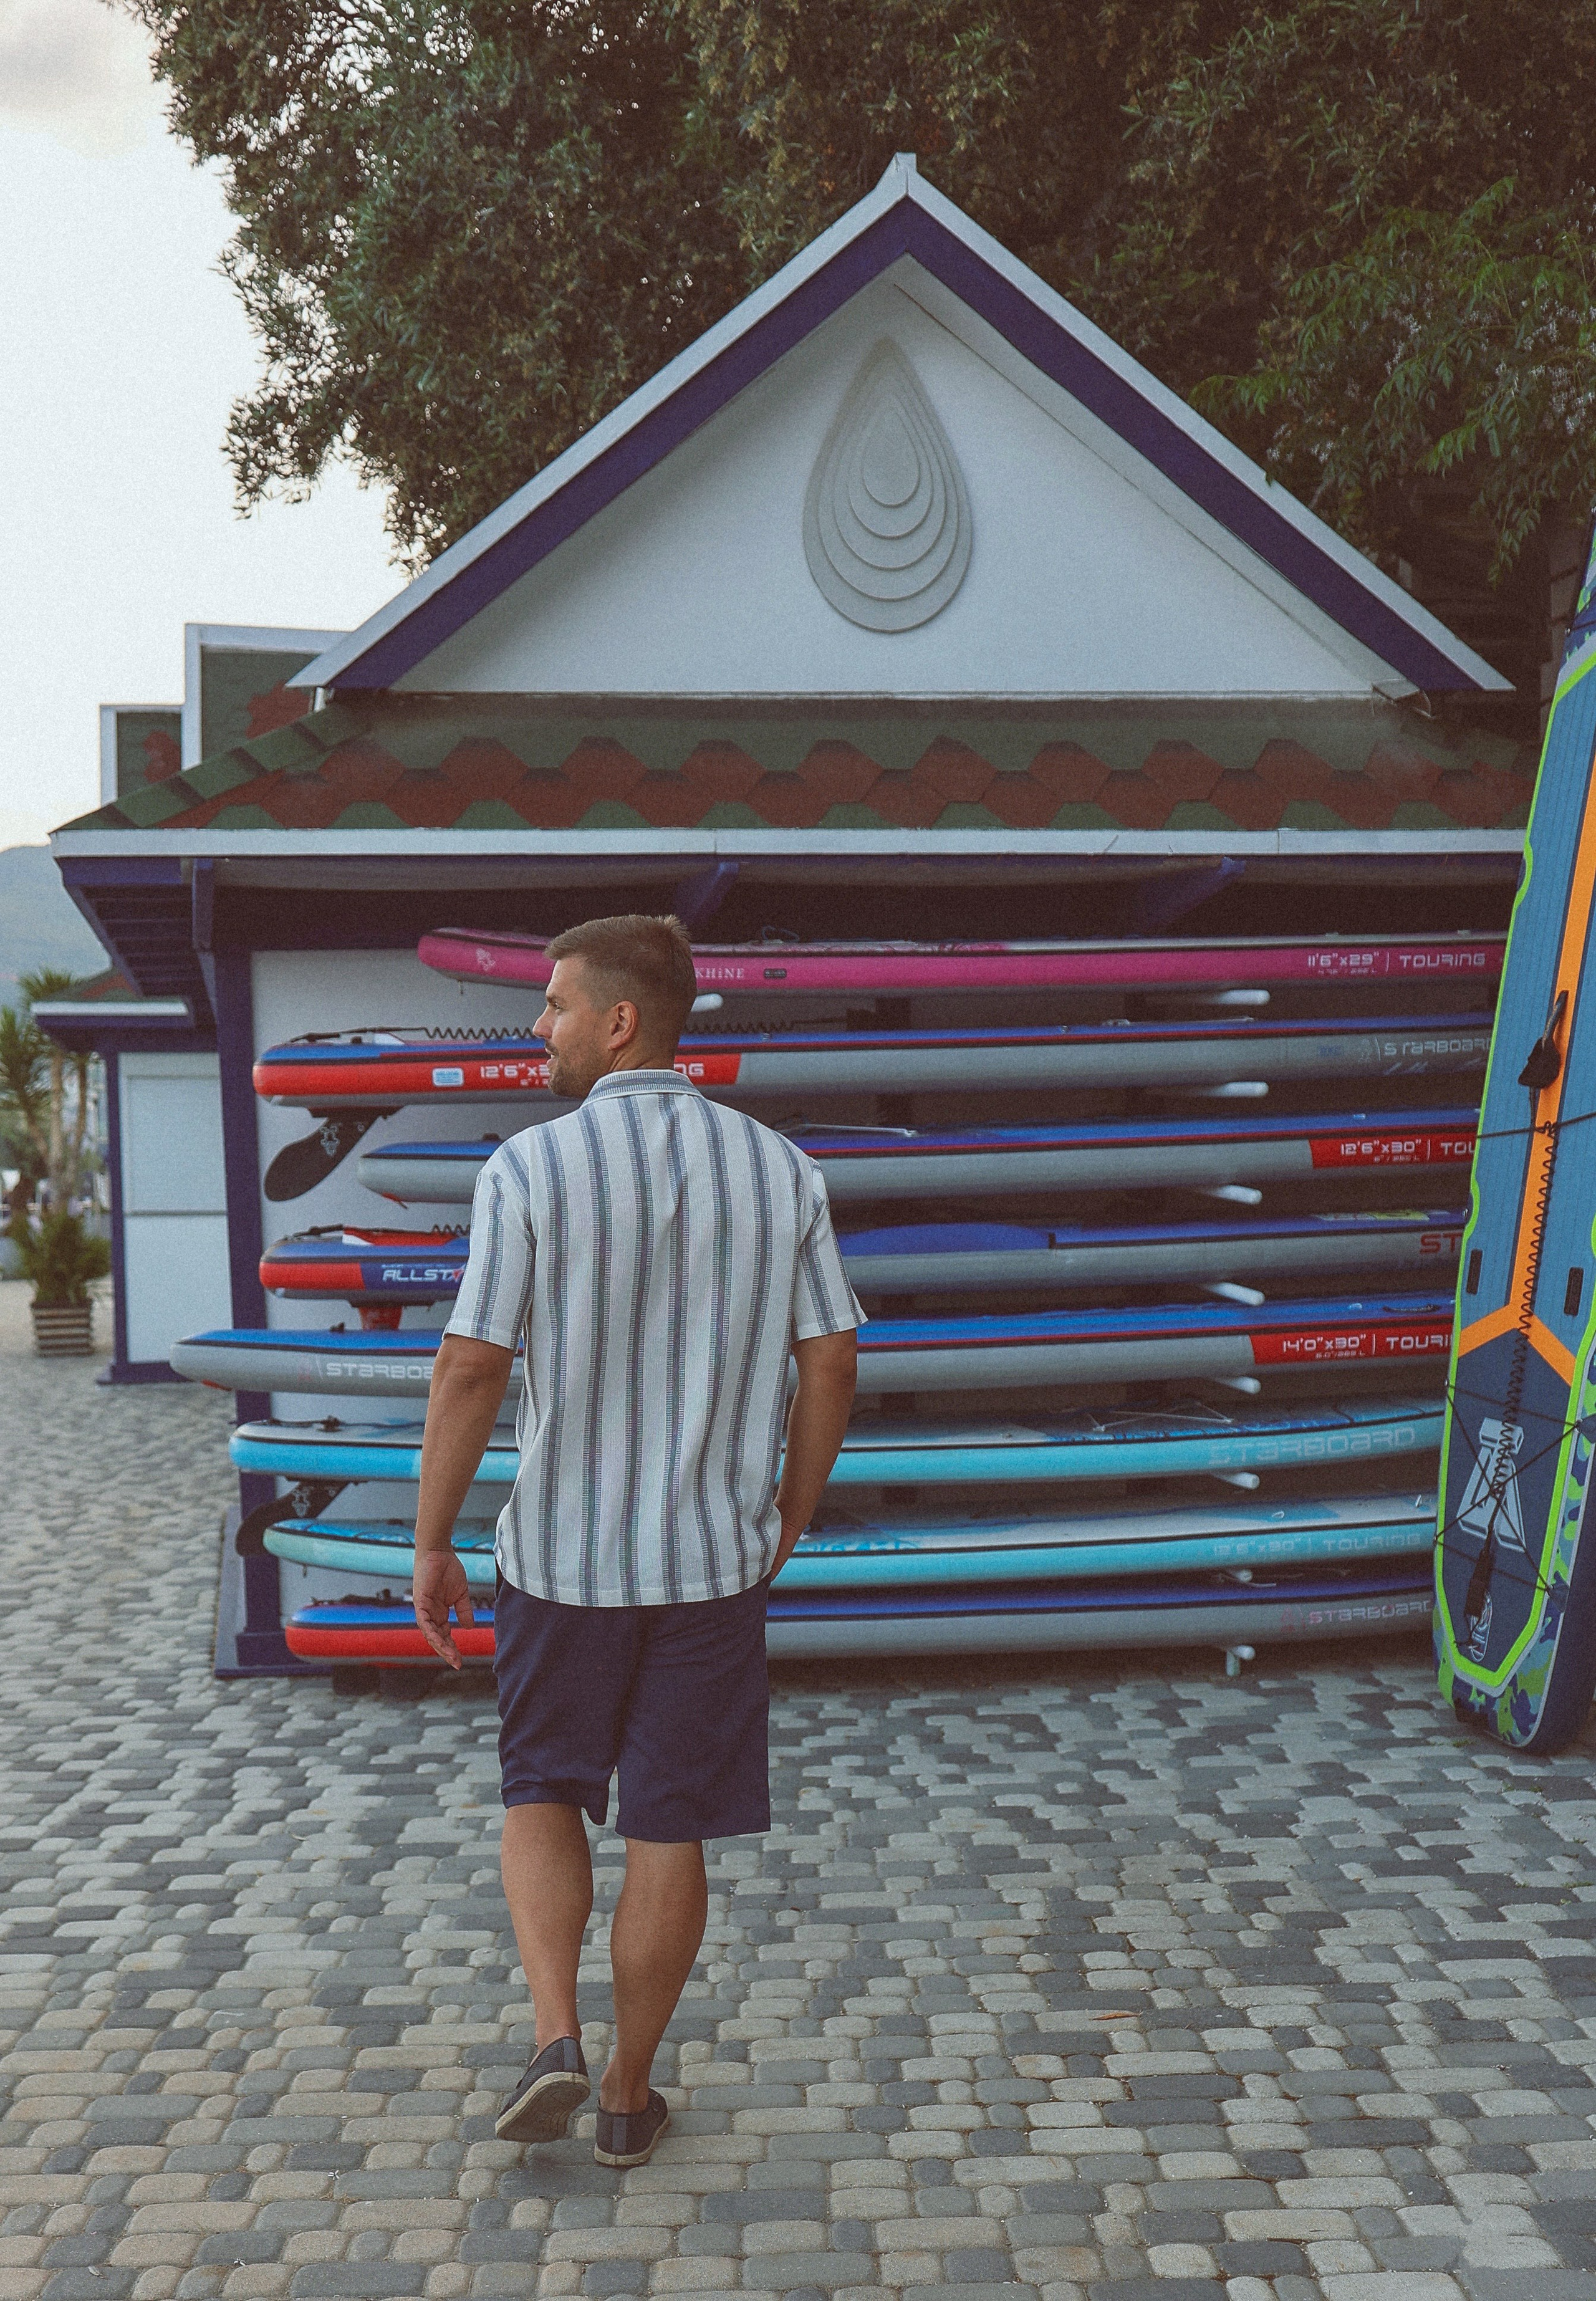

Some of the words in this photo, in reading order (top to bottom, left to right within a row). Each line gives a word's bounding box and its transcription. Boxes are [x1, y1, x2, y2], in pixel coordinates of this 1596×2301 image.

[1400, 953, 1486, 968] TOURING
[1419, 1231, 1463, 1255] ST
[1386, 1334, 1453, 1350] TOURI
[326, 1362, 433, 1379] STARBOA
[1323, 1533, 1420, 1551] TOURING
